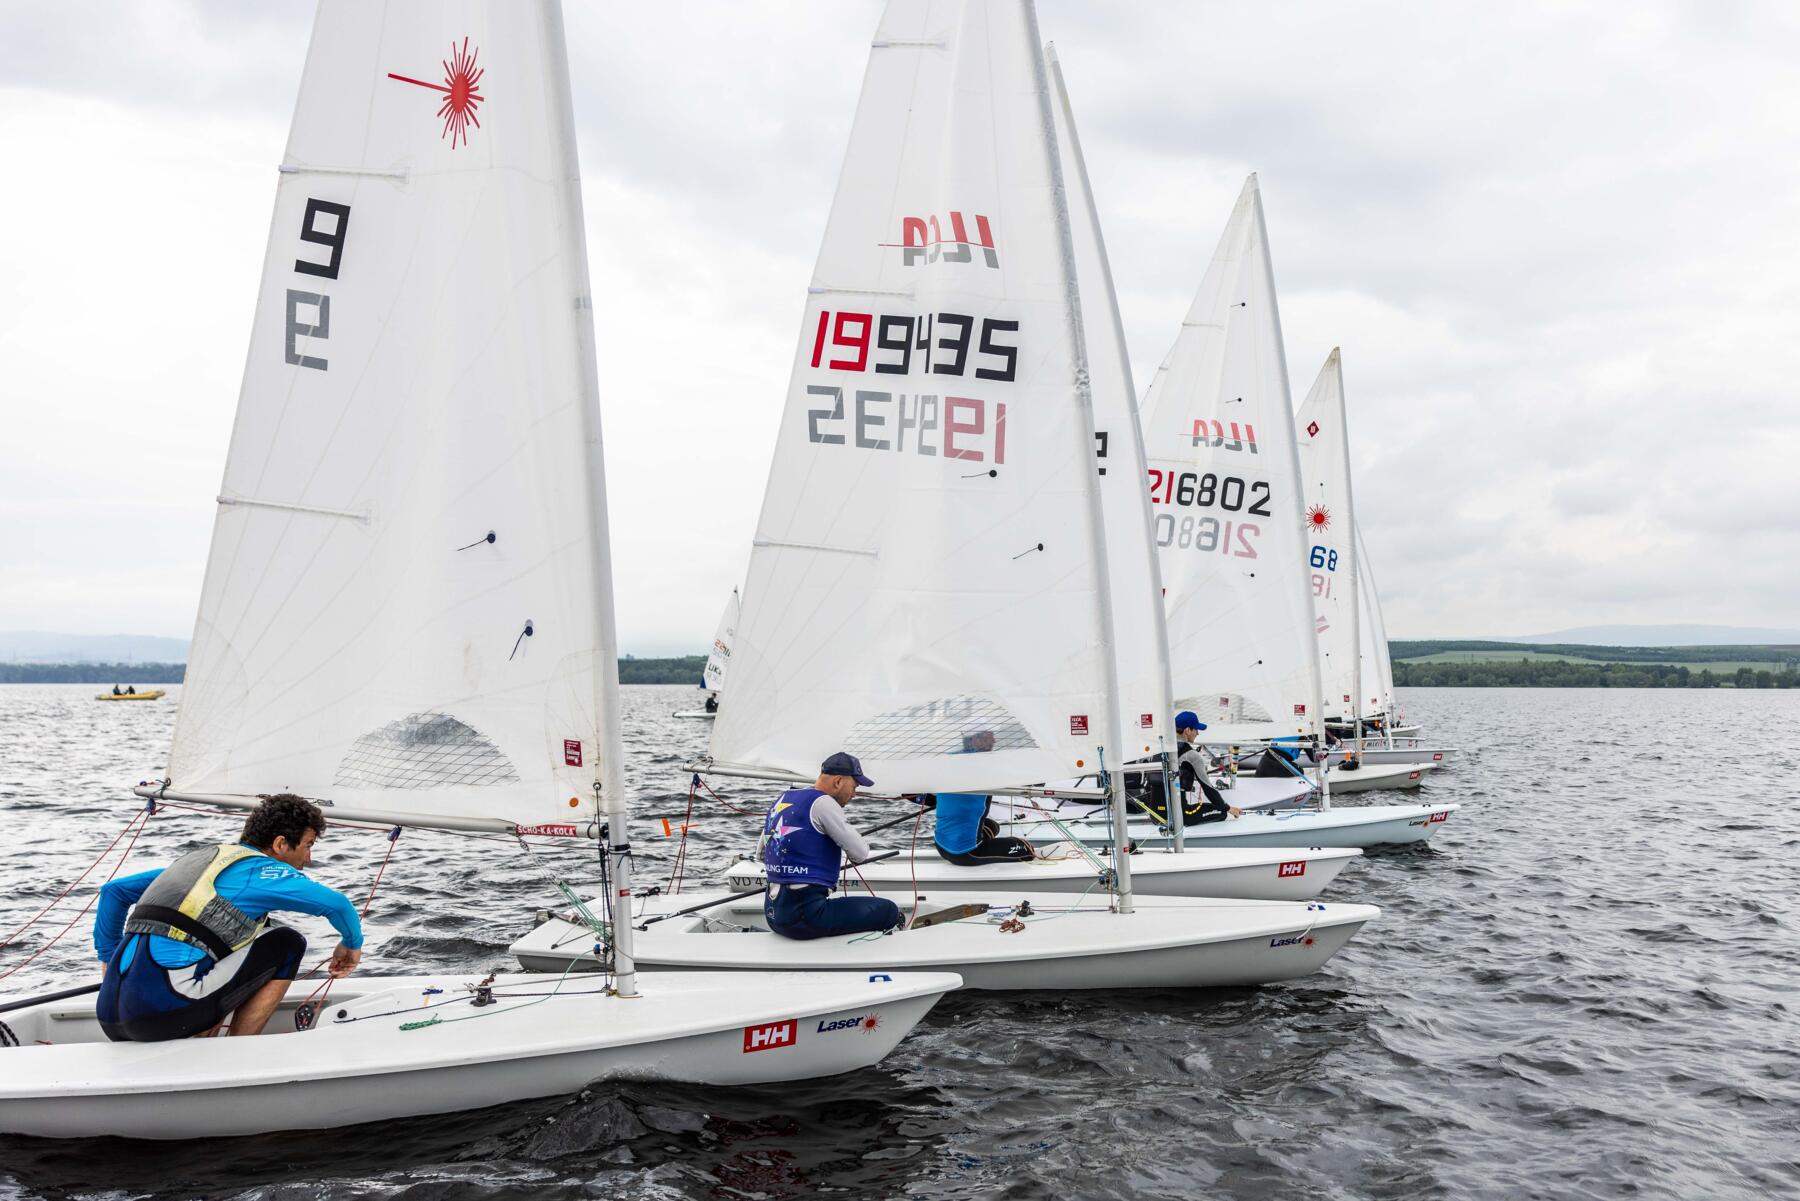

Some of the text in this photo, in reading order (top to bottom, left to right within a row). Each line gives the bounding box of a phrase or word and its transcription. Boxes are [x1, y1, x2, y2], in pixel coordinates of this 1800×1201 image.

[294, 197, 351, 280] 9
[811, 310, 1019, 382] 199435
[1148, 469, 1271, 517] 216802
[1309, 545, 1338, 572] 68
[1432, 811, 1447, 821] HH
[782, 865, 808, 875] TEAM
[1282, 863, 1302, 875] HH
[1270, 936, 1304, 947] Laser
[816, 1016, 864, 1033] Laser
[751, 1024, 790, 1047] HH
